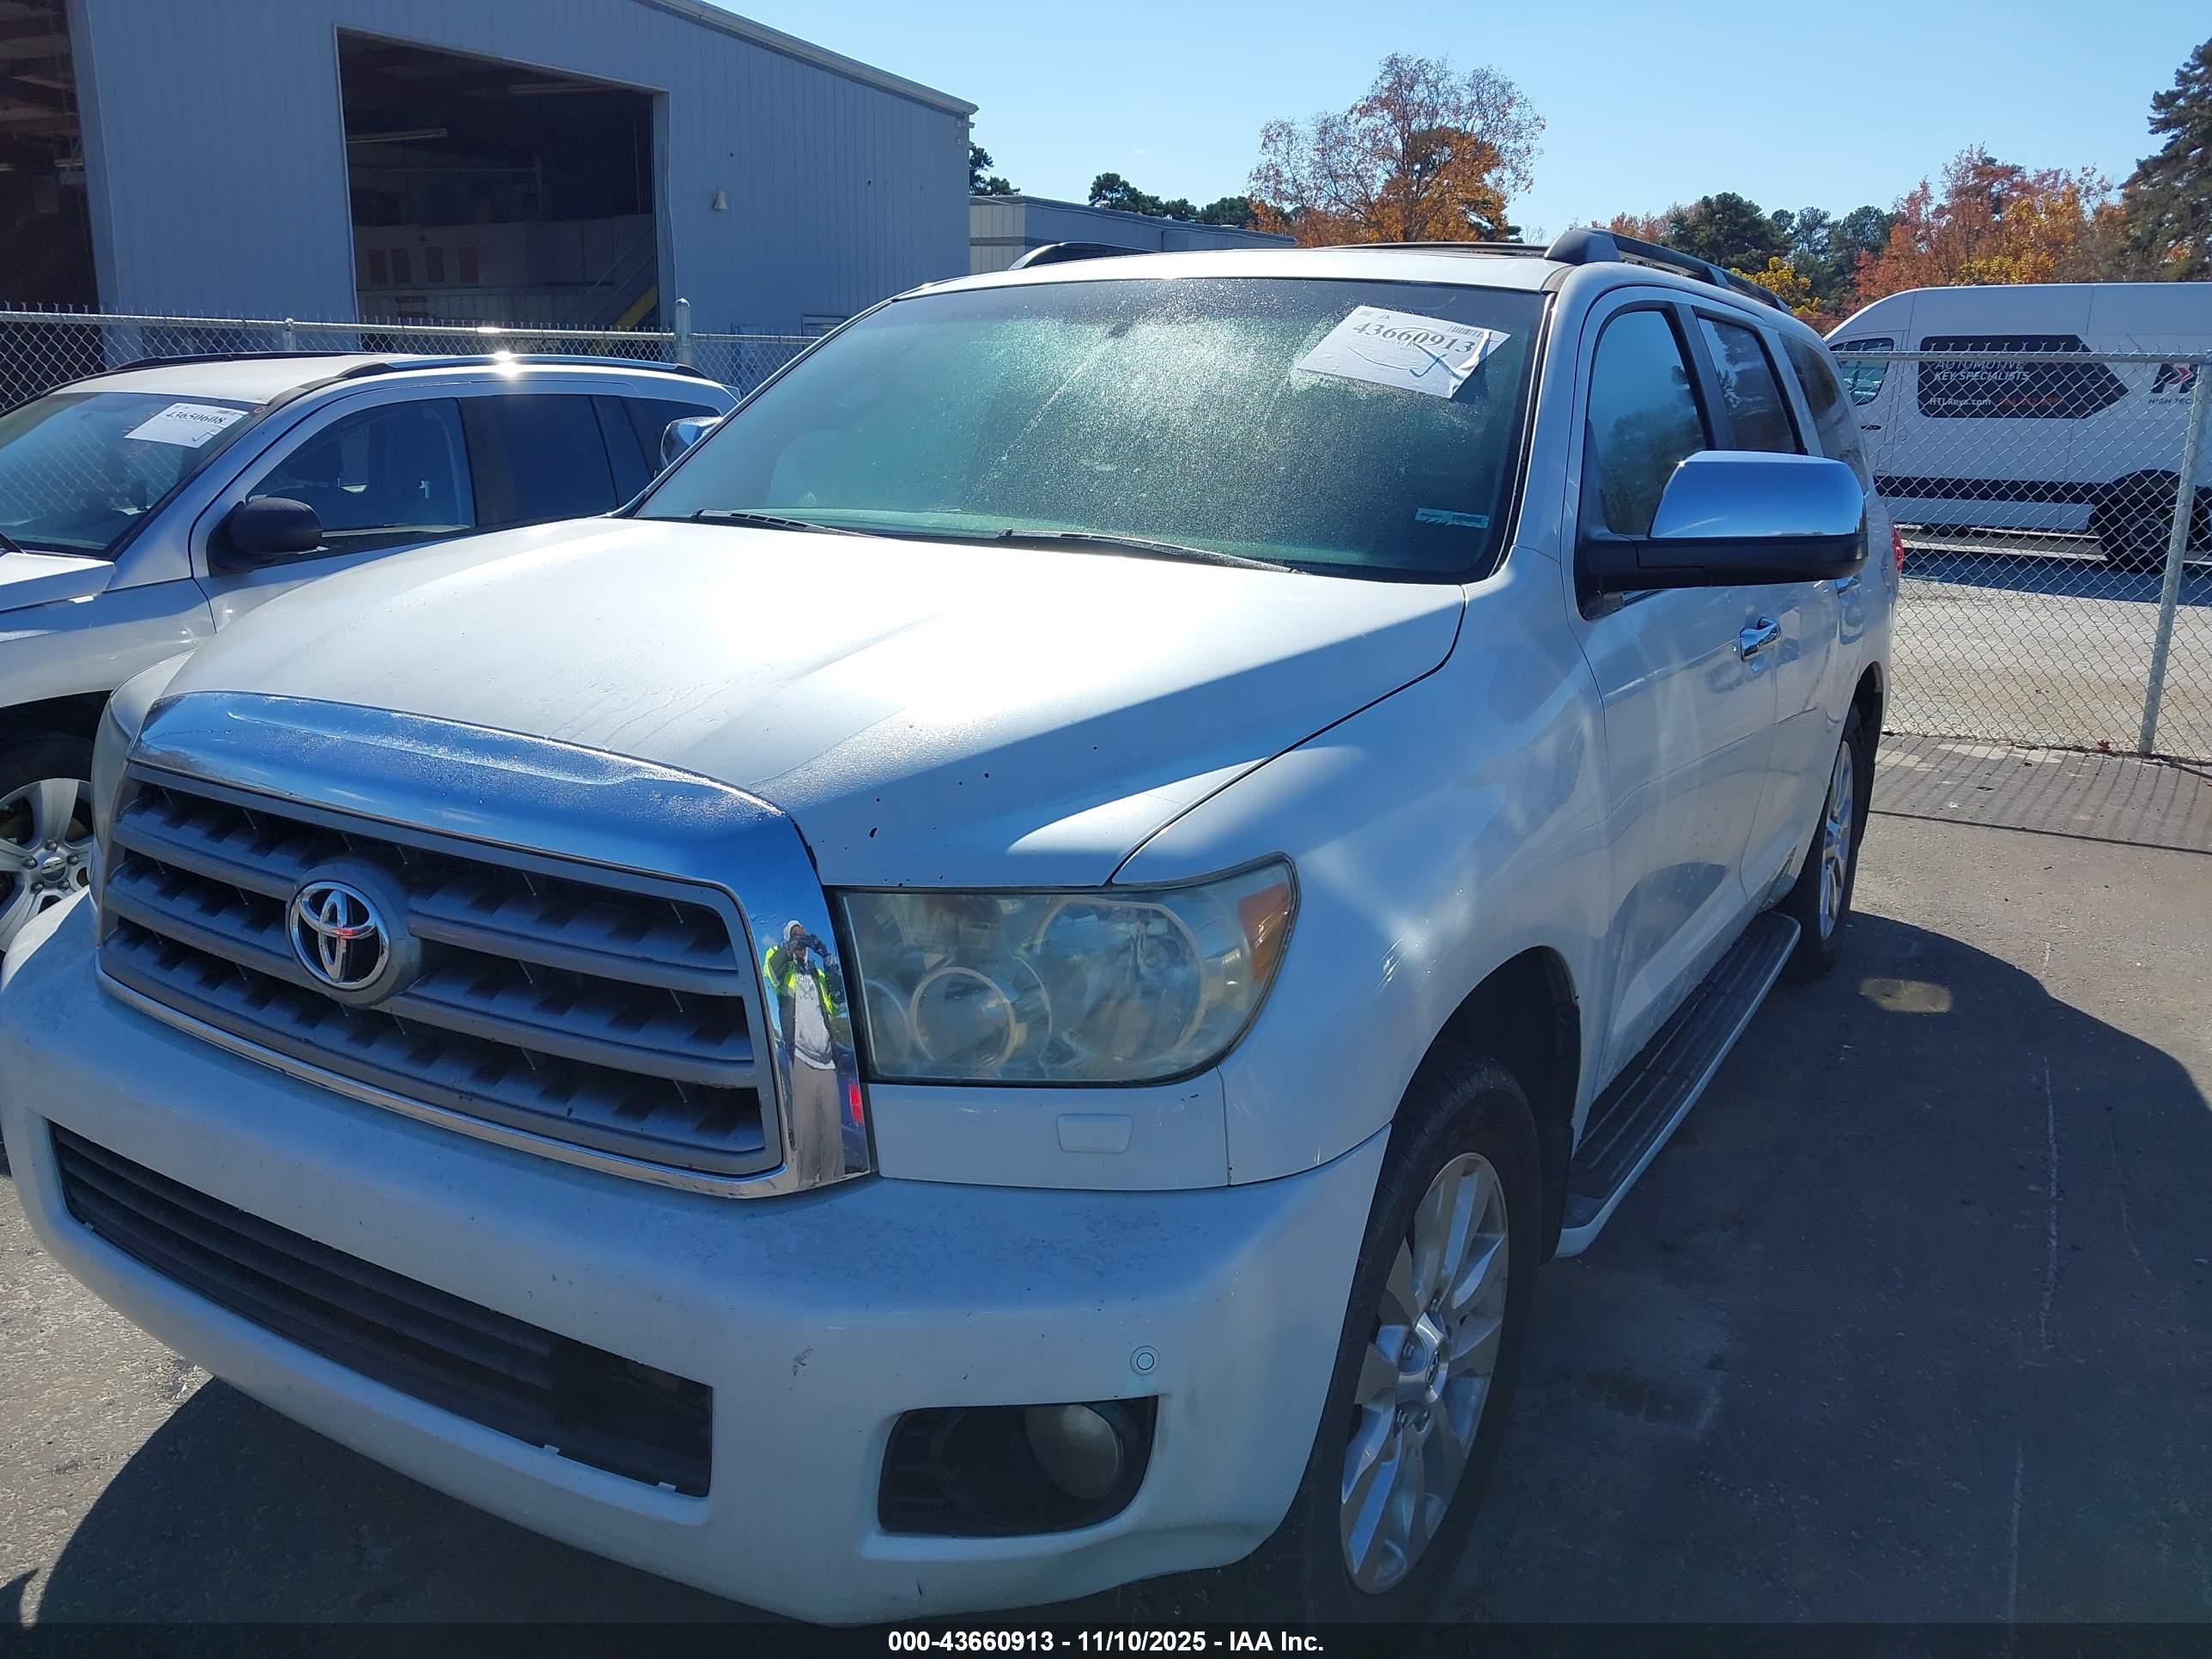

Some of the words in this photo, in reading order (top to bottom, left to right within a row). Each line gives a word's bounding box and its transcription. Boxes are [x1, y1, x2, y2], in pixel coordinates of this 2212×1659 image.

[1352, 322, 1476, 353] 43660913
[1936, 371, 1958, 380] KEY
[1960, 371, 2030, 381] SPECIALISTS
[166, 410, 227, 423] 43650608
